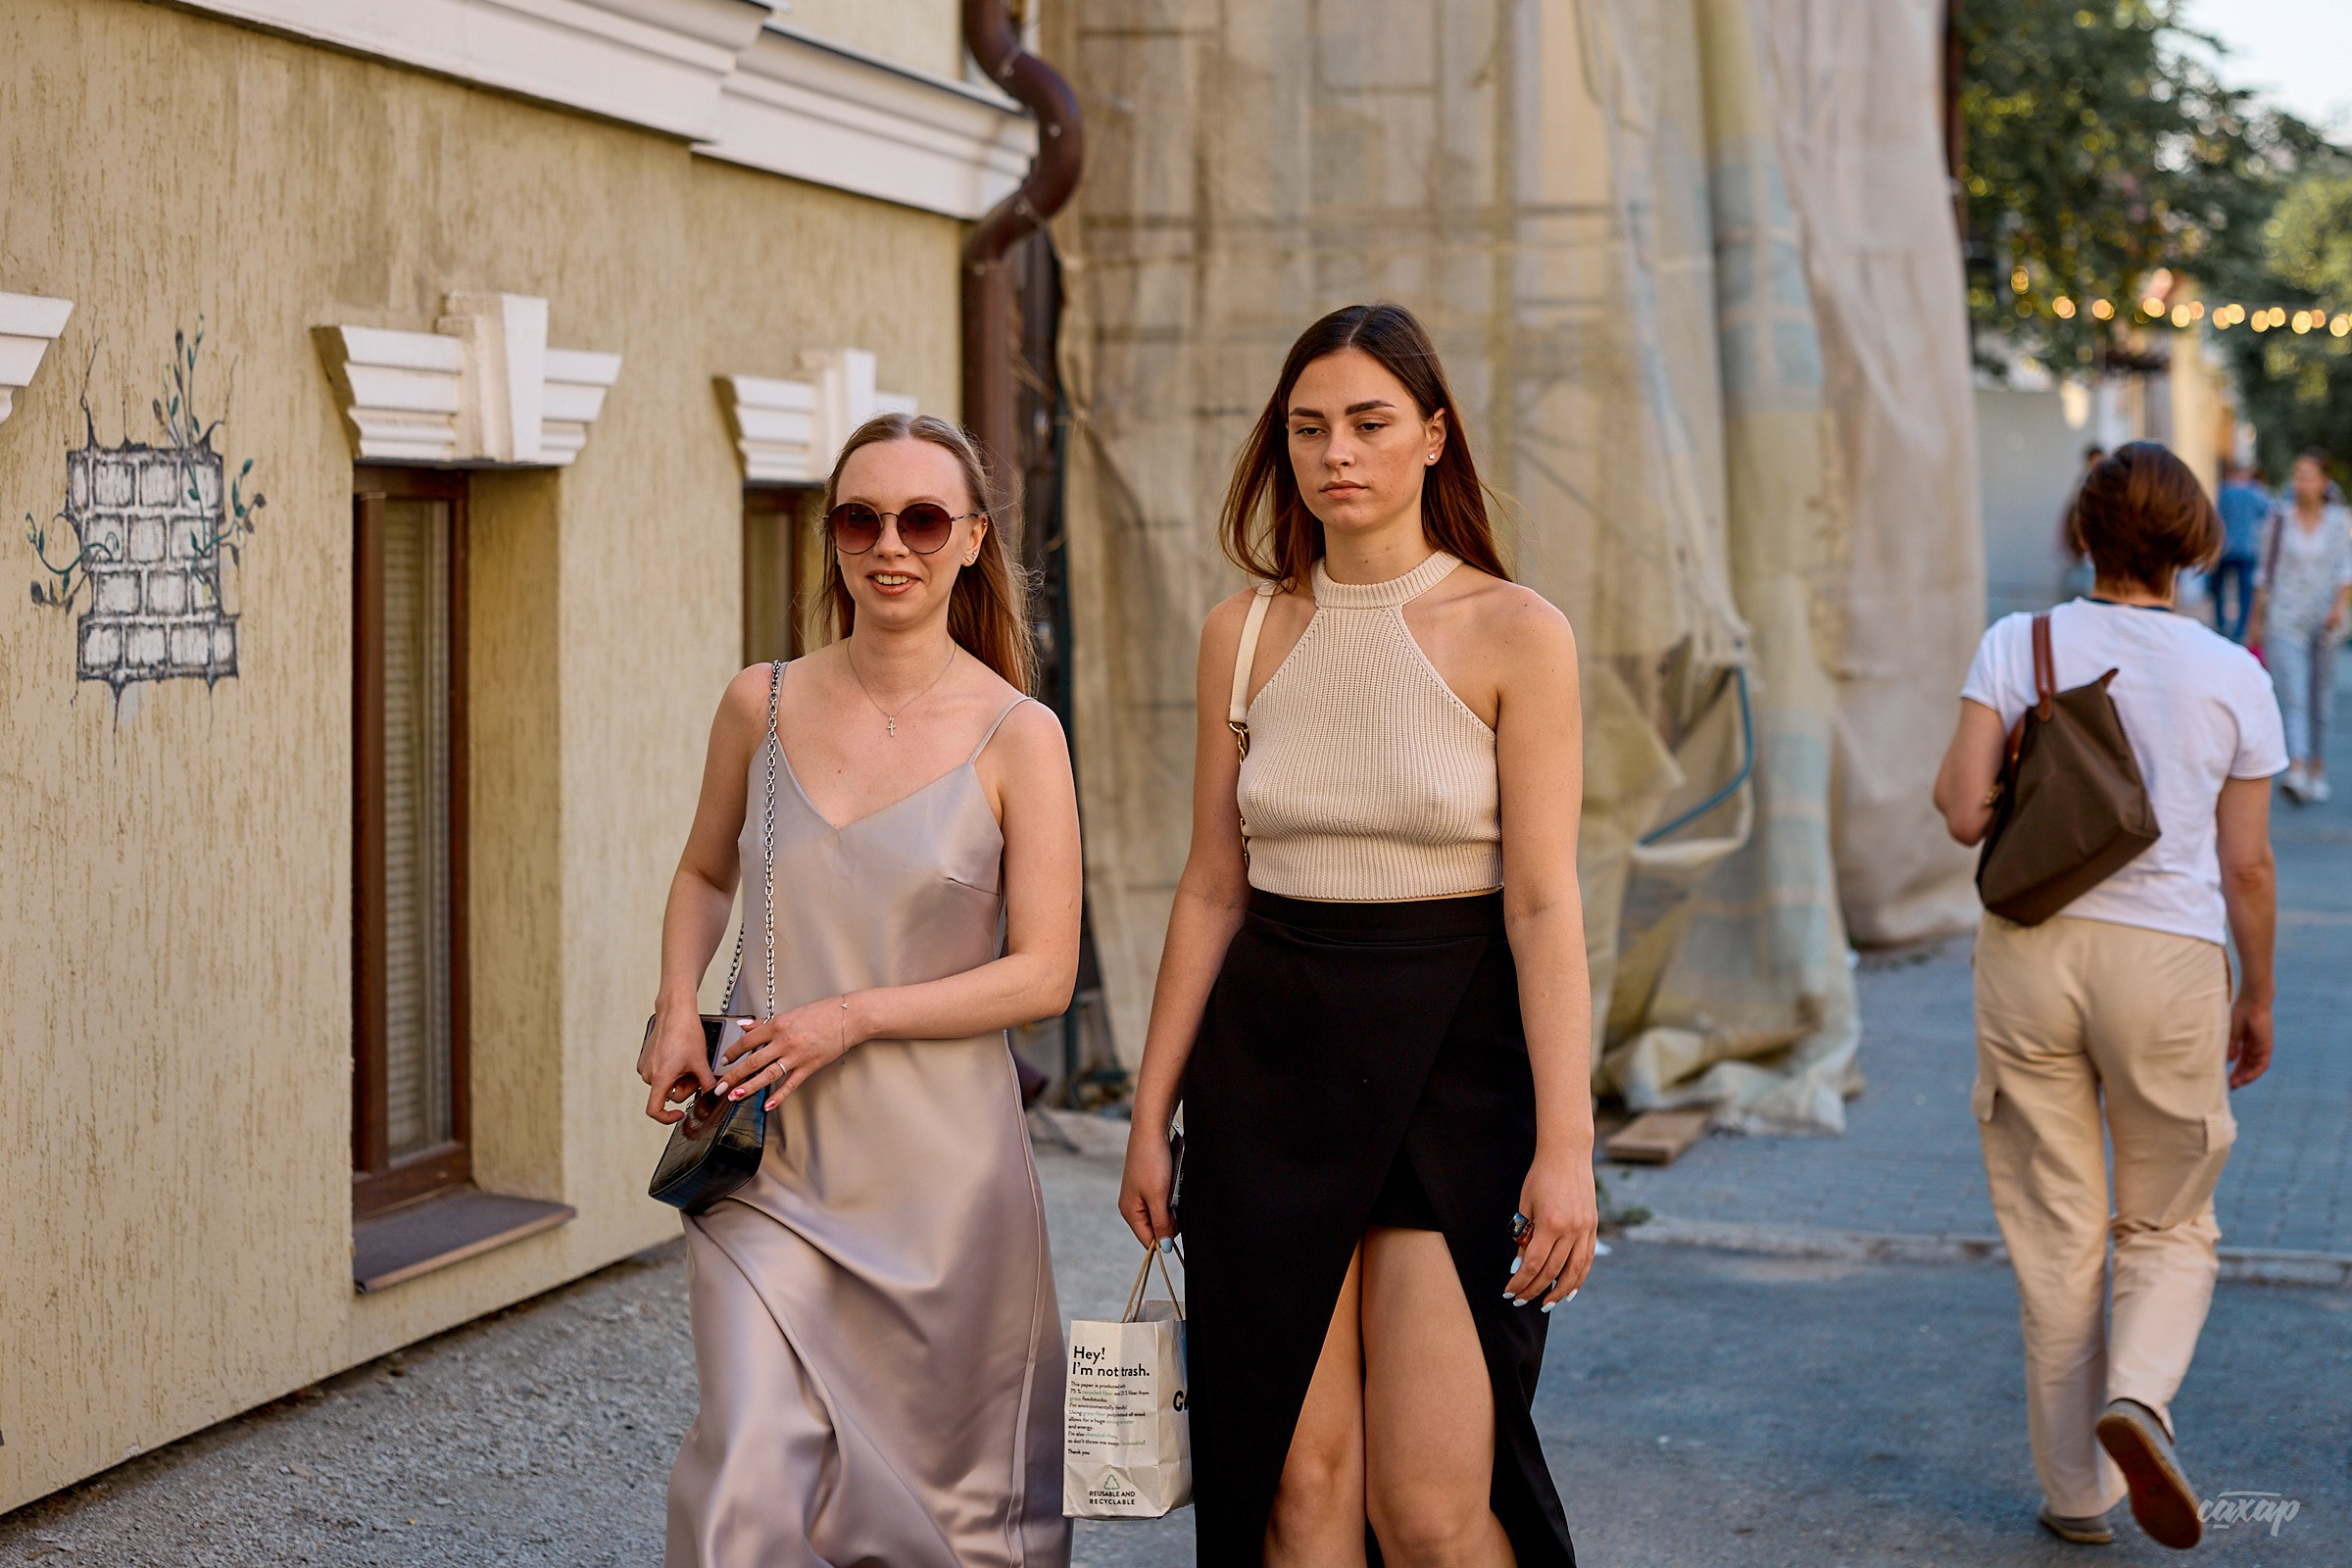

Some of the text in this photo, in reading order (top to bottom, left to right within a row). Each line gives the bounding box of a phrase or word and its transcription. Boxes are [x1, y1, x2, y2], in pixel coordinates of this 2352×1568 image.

[1073, 1345, 1105, 1365] Hey!
[1072, 1361, 1151, 1377] I'm not trash.
